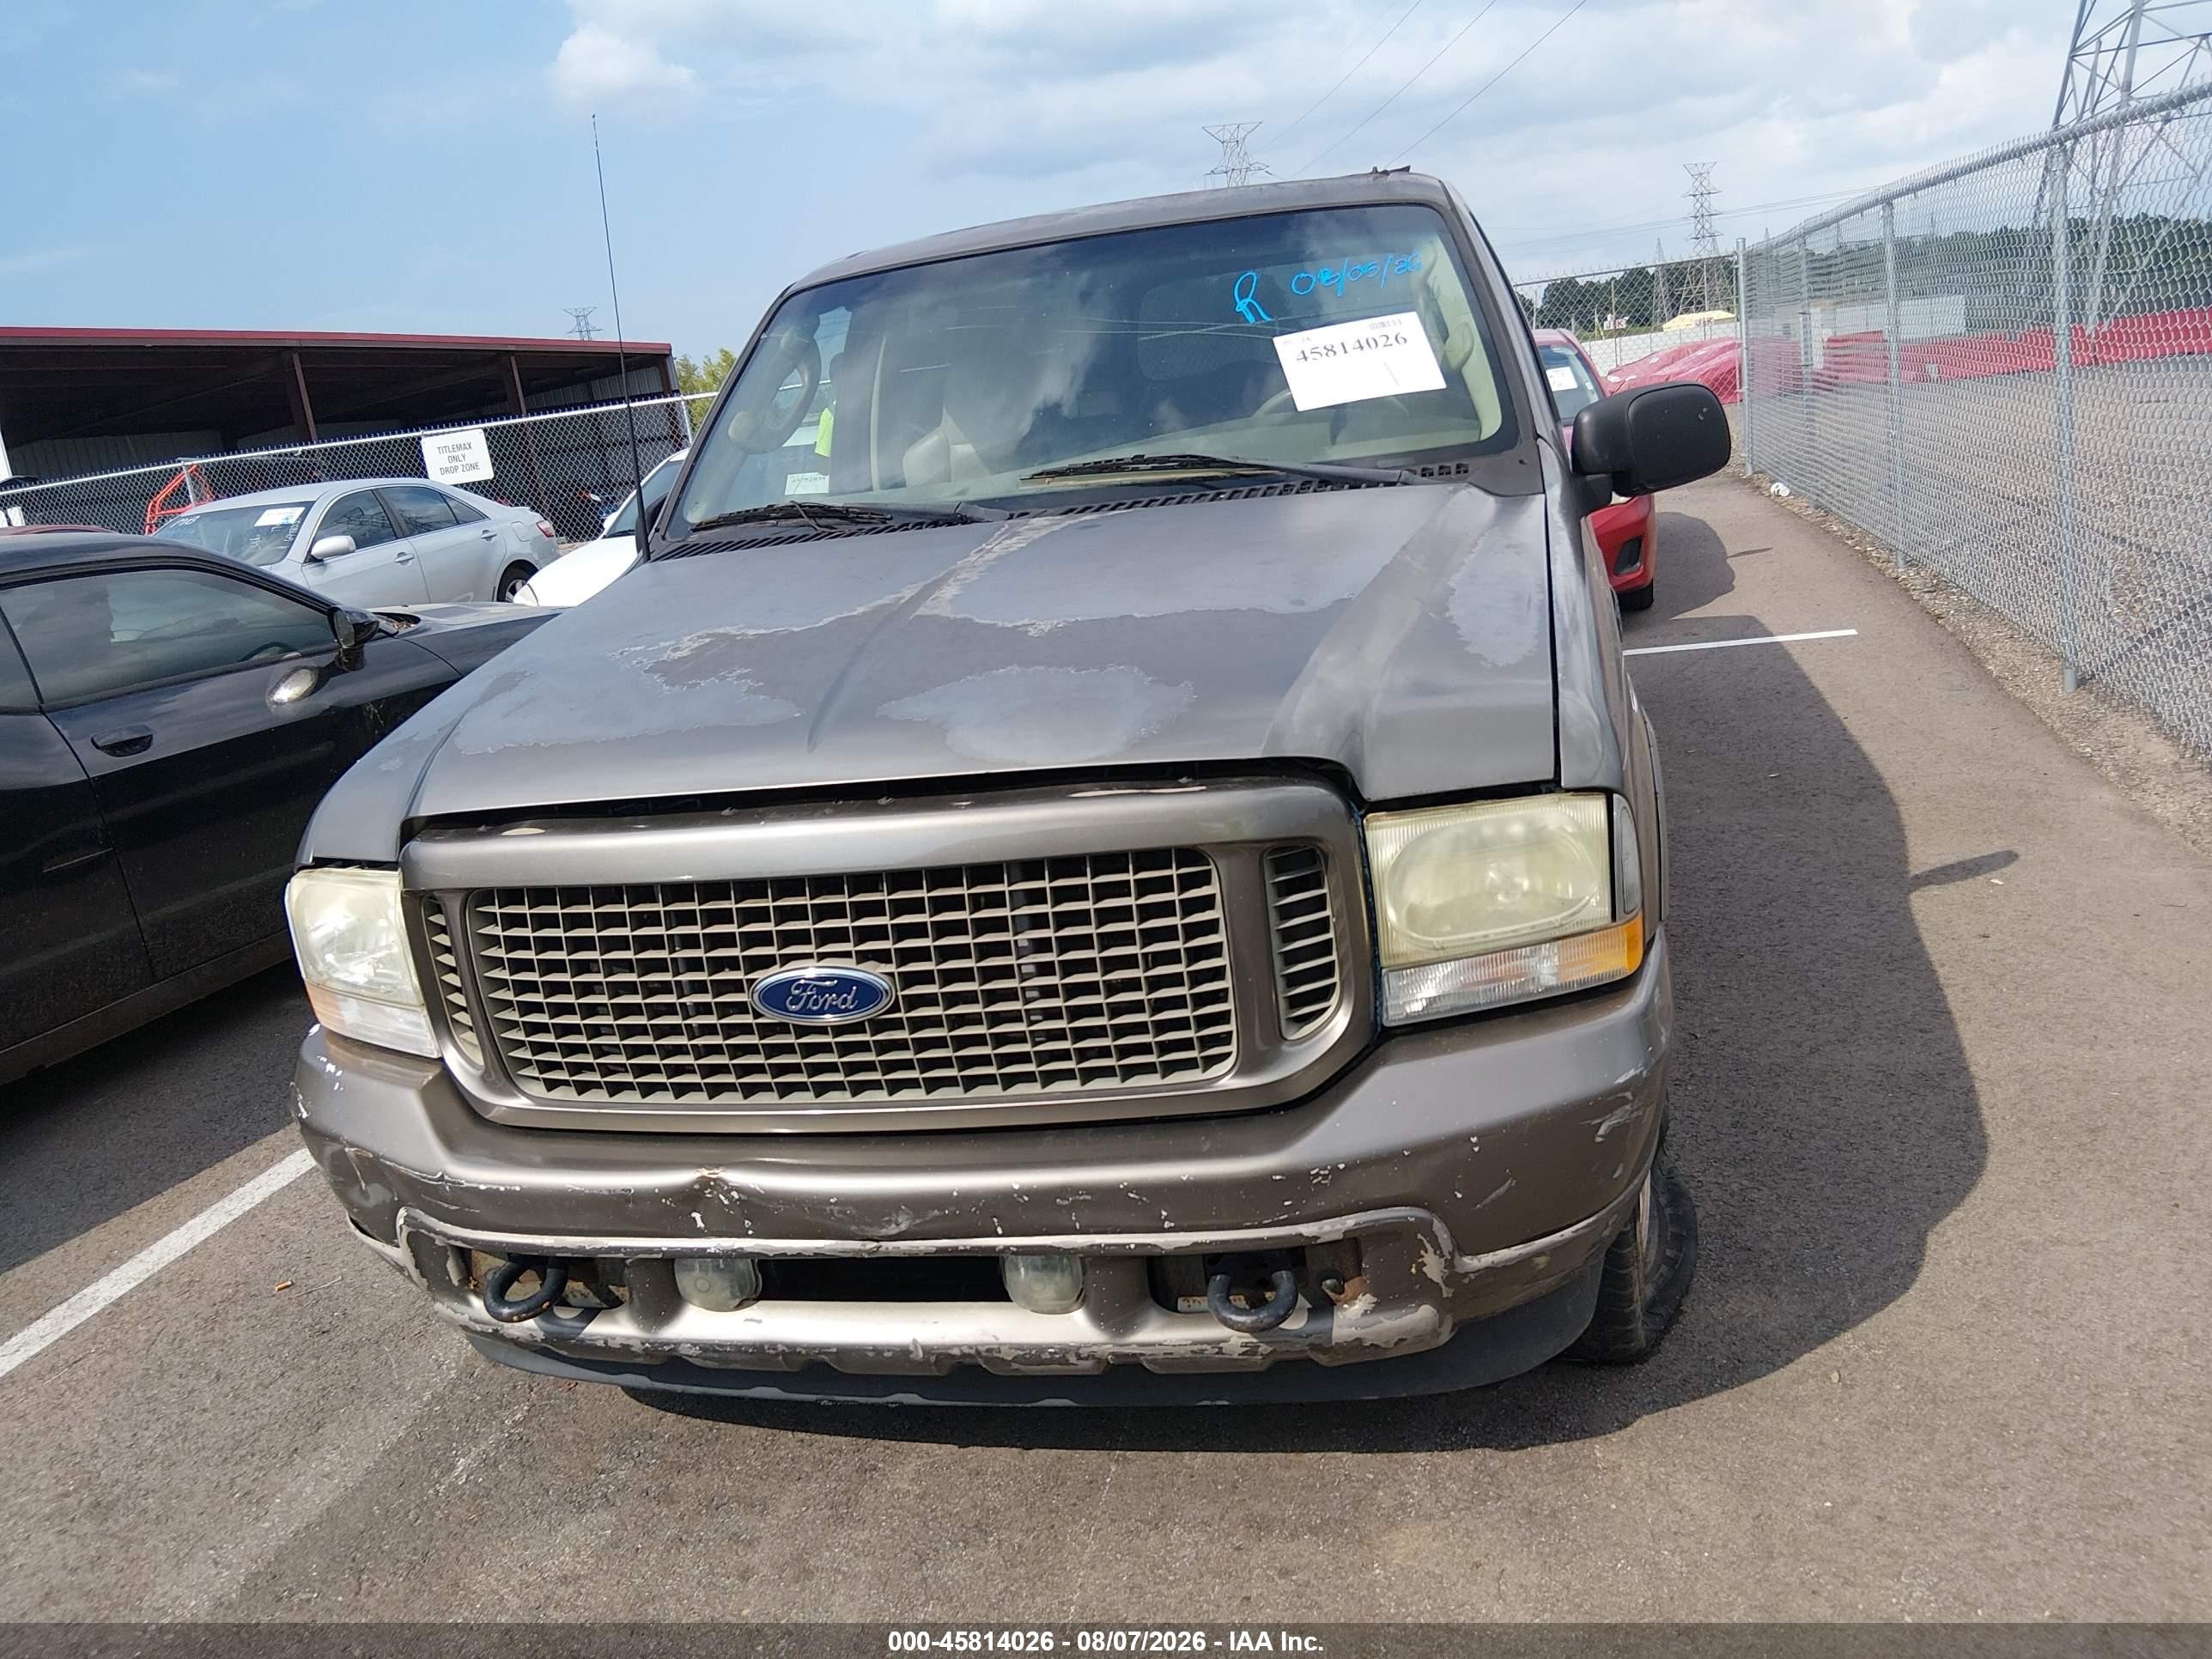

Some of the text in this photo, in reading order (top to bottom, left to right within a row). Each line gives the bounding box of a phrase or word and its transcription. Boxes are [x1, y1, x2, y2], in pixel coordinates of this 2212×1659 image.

[1296, 331, 1408, 362] 45814026
[436, 441, 473, 455] TITLEMAX
[447, 453, 466, 464] ONLY
[440, 461, 481, 476] DROP ZONE
[786, 979, 858, 1011] Ford
